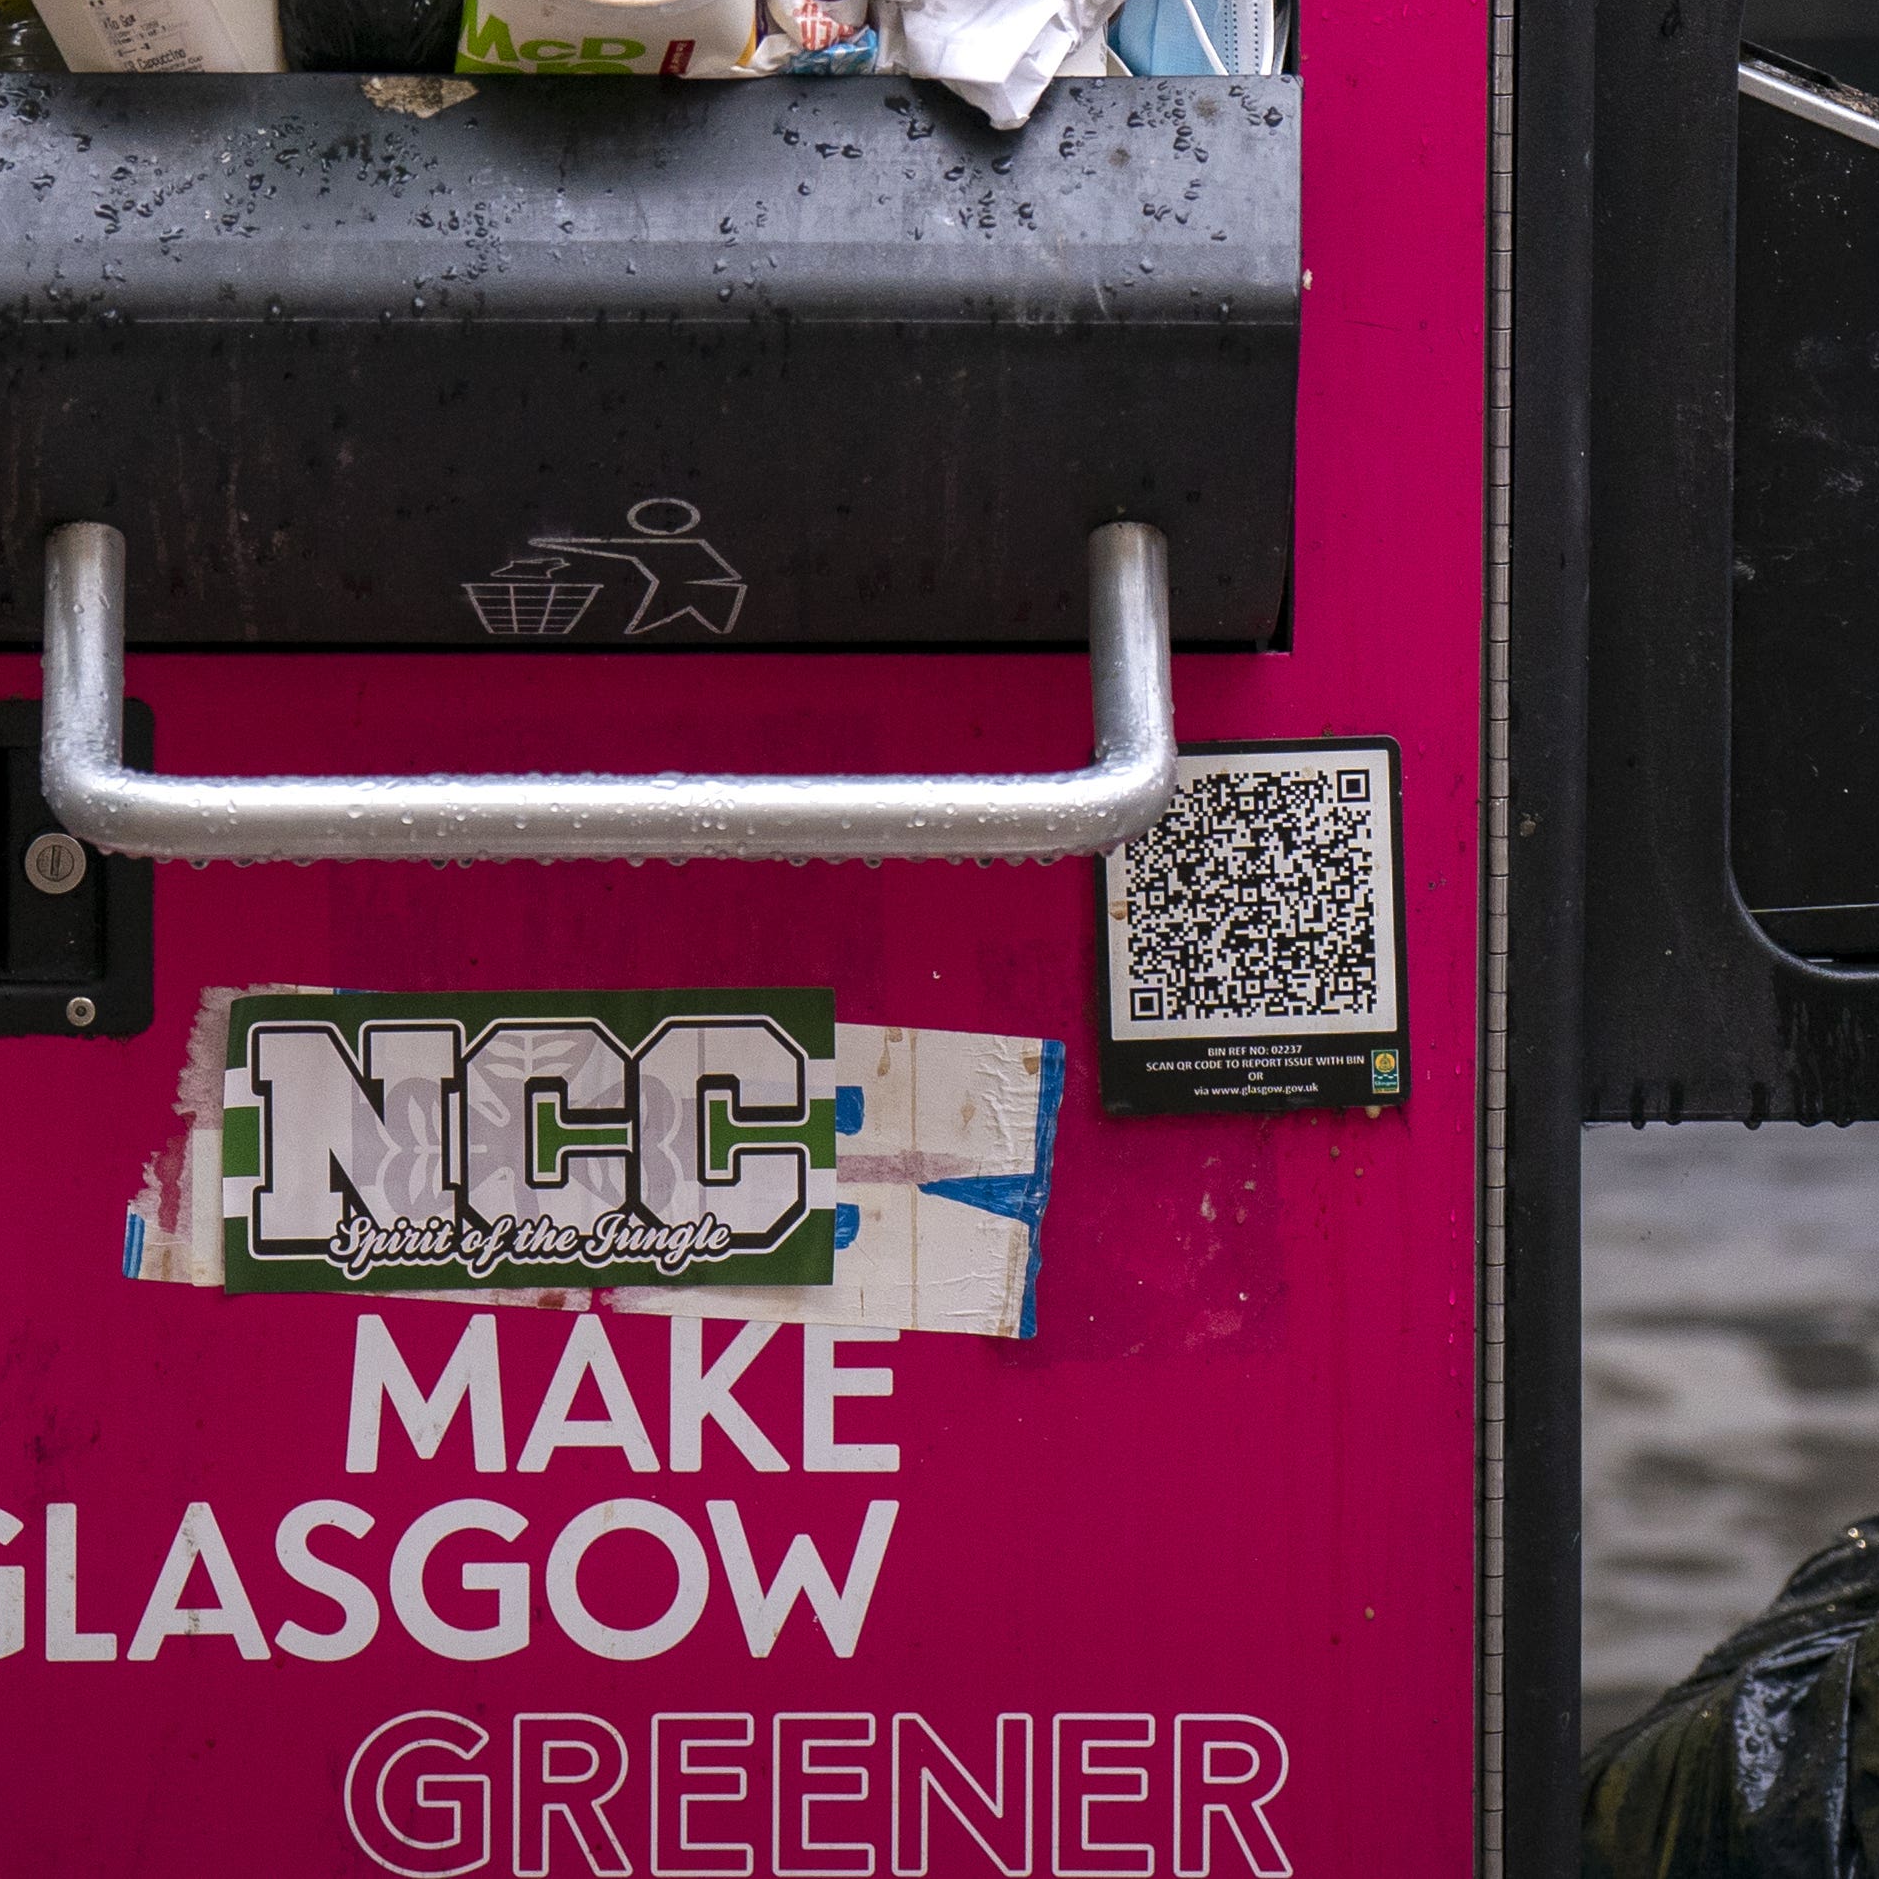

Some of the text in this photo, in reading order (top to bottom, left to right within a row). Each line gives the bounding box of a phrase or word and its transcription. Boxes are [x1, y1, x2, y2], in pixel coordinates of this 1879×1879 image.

[1146, 1055, 1365, 1072] SCAN QR CODE TO REPORT ISSUE WITH BIN
[1208, 1044, 1302, 1057] BIN REF NO: 02237
[1194, 1082, 1319, 1097] via www.glasgow.gov.uk
[1248, 1071, 1264, 1081] OR
[248, 1016, 810, 1257] NCC
[330, 1213, 730, 1268] Spirit of the Jungle
[344, 1313, 901, 1474] MAKE
[342, 1709, 1294, 1879] GREENER
